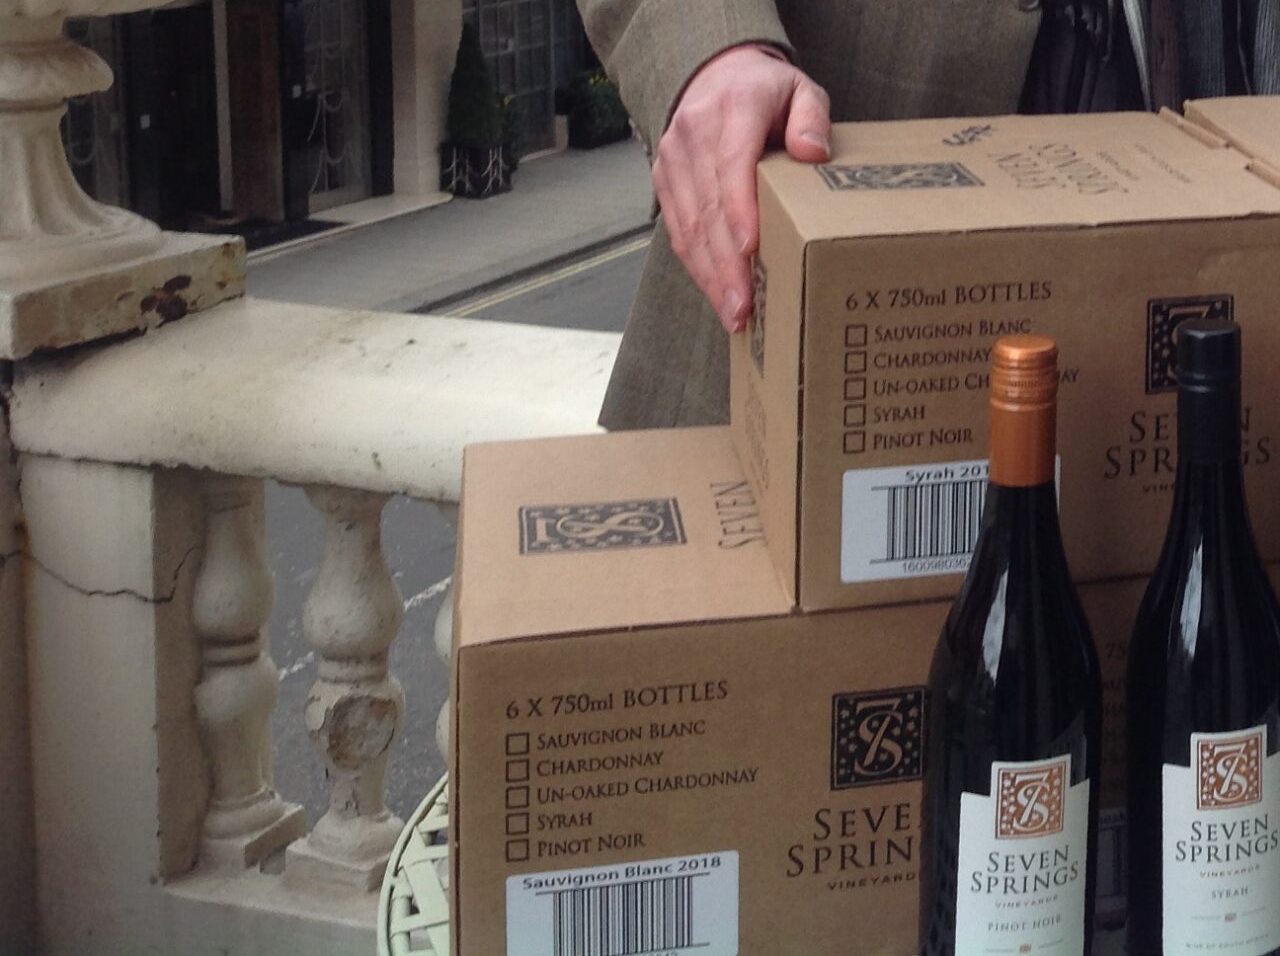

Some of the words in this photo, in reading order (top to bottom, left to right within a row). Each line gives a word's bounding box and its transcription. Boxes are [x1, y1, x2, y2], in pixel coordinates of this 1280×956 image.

[846, 293, 858, 311] 6
[866, 292, 880, 309] X
[889, 288, 946, 308] 750ml
[955, 280, 1052, 304] BOTTLES
[874, 322, 972, 343] SAUVIGNON
[978, 318, 1032, 336] BLANC
[873, 347, 993, 369] CHARDONNAY
[873, 376, 959, 396] UN-OAKED
[873, 405, 926, 424] SYRAH
[873, 432, 924, 450] PINOT
[930, 428, 974, 446] NOIR
[904, 464, 955, 485] Syrah
[961, 465, 989, 478] 201
[505, 701, 520, 720] 6
[527, 697, 544, 717] X
[551, 693, 614, 715] 750ml
[622, 680, 729, 709] BOTTLES
[537, 726, 643, 751] SAUVIGNON
[649, 719, 706, 740] BLANC
[536, 751, 665, 777] CHARDONNAY
[537, 782, 629, 805] UN-OAKED
[634, 767, 760, 795] CHARDONNAY
[537, 812, 593, 831] SYRAH
[813, 802, 911, 842] SEVE
[1190, 812, 1268, 843] SEVEN
[537, 838, 592, 858] PINOT
[598, 833, 647, 851] NOIR
[786, 835, 913, 878] SPRIN
[1175, 829, 1280, 863] SPRINGS
[987, 844, 1069, 874] SEVEN
[522, 870, 620, 892] Sauvignon
[625, 863, 674, 879] Blanc
[678, 856, 722, 872] 2018
[828, 872, 916, 891] VINEYARD
[970, 860, 1079, 895] SPRINGS
[1211, 886, 1249, 900] SYRAH
[987, 921, 1027, 933] PINOT
[1032, 913, 1062, 931] NOIR
